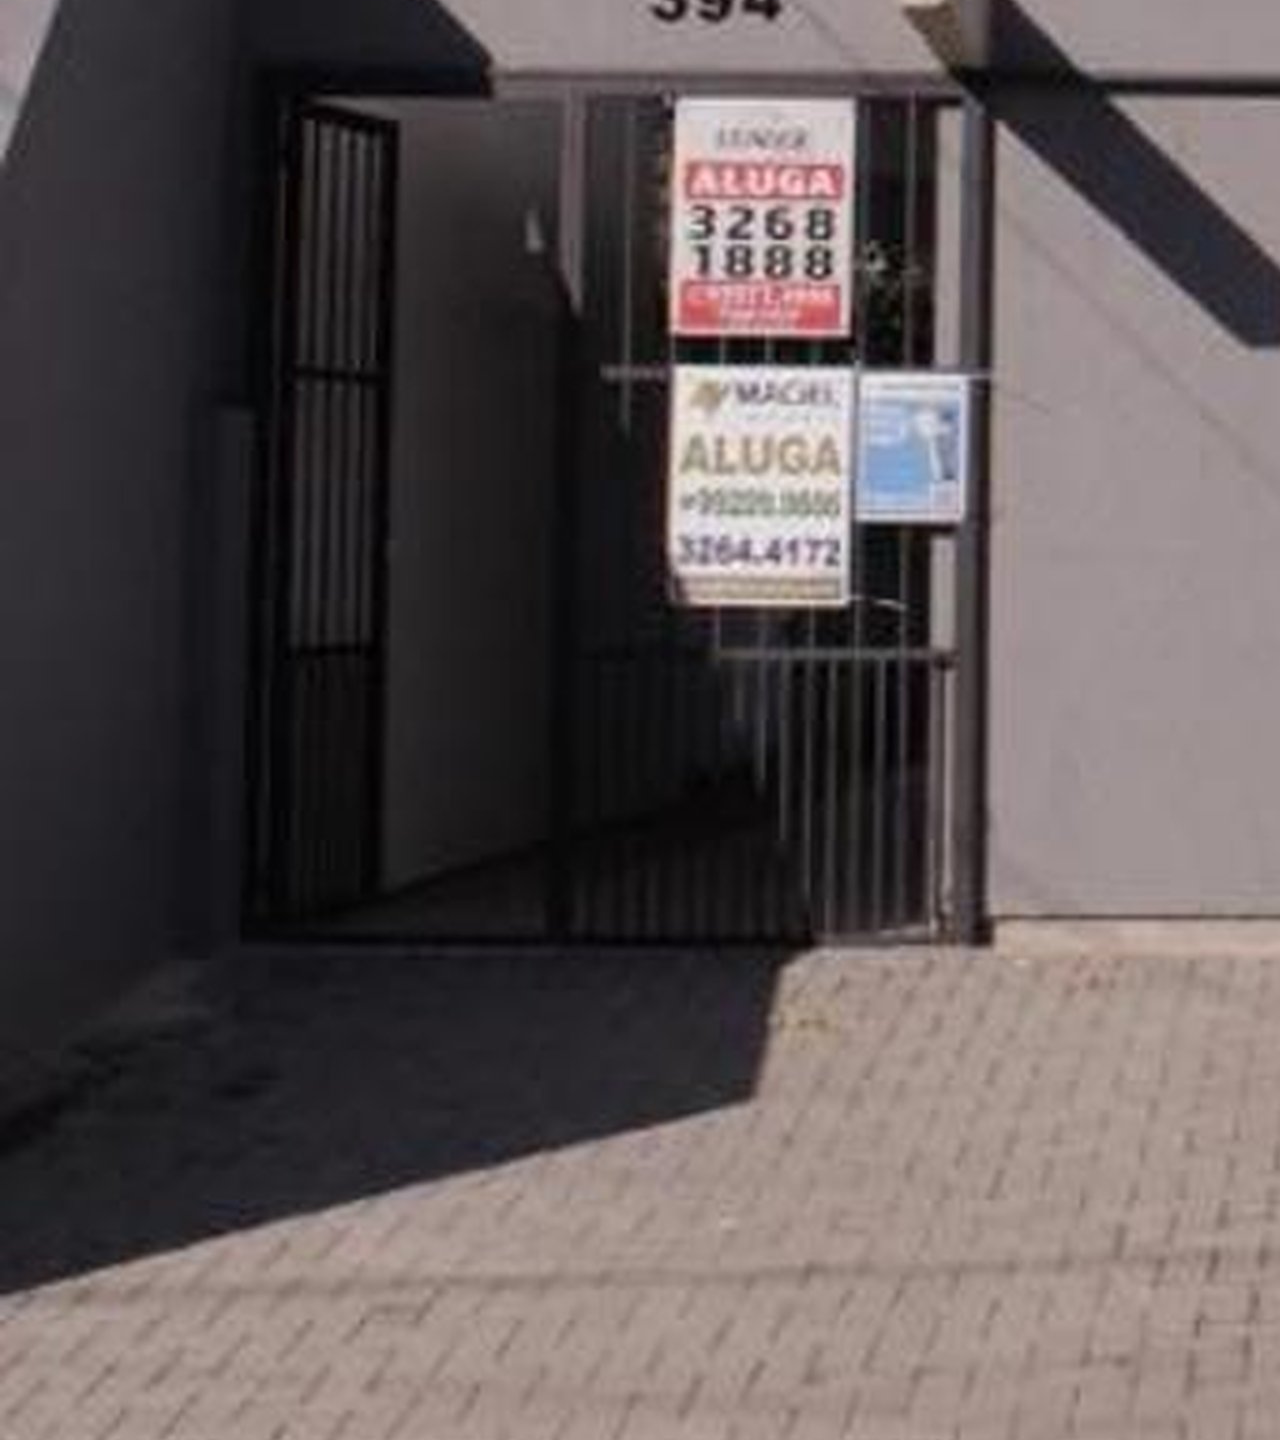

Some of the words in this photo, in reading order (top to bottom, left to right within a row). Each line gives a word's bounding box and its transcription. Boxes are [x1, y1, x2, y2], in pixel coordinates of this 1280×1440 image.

[690, 166, 837, 197] ALUGA
[688, 206, 836, 241] 3268
[694, 244, 834, 281] 1888
[679, 433, 841, 476] ALUGA
